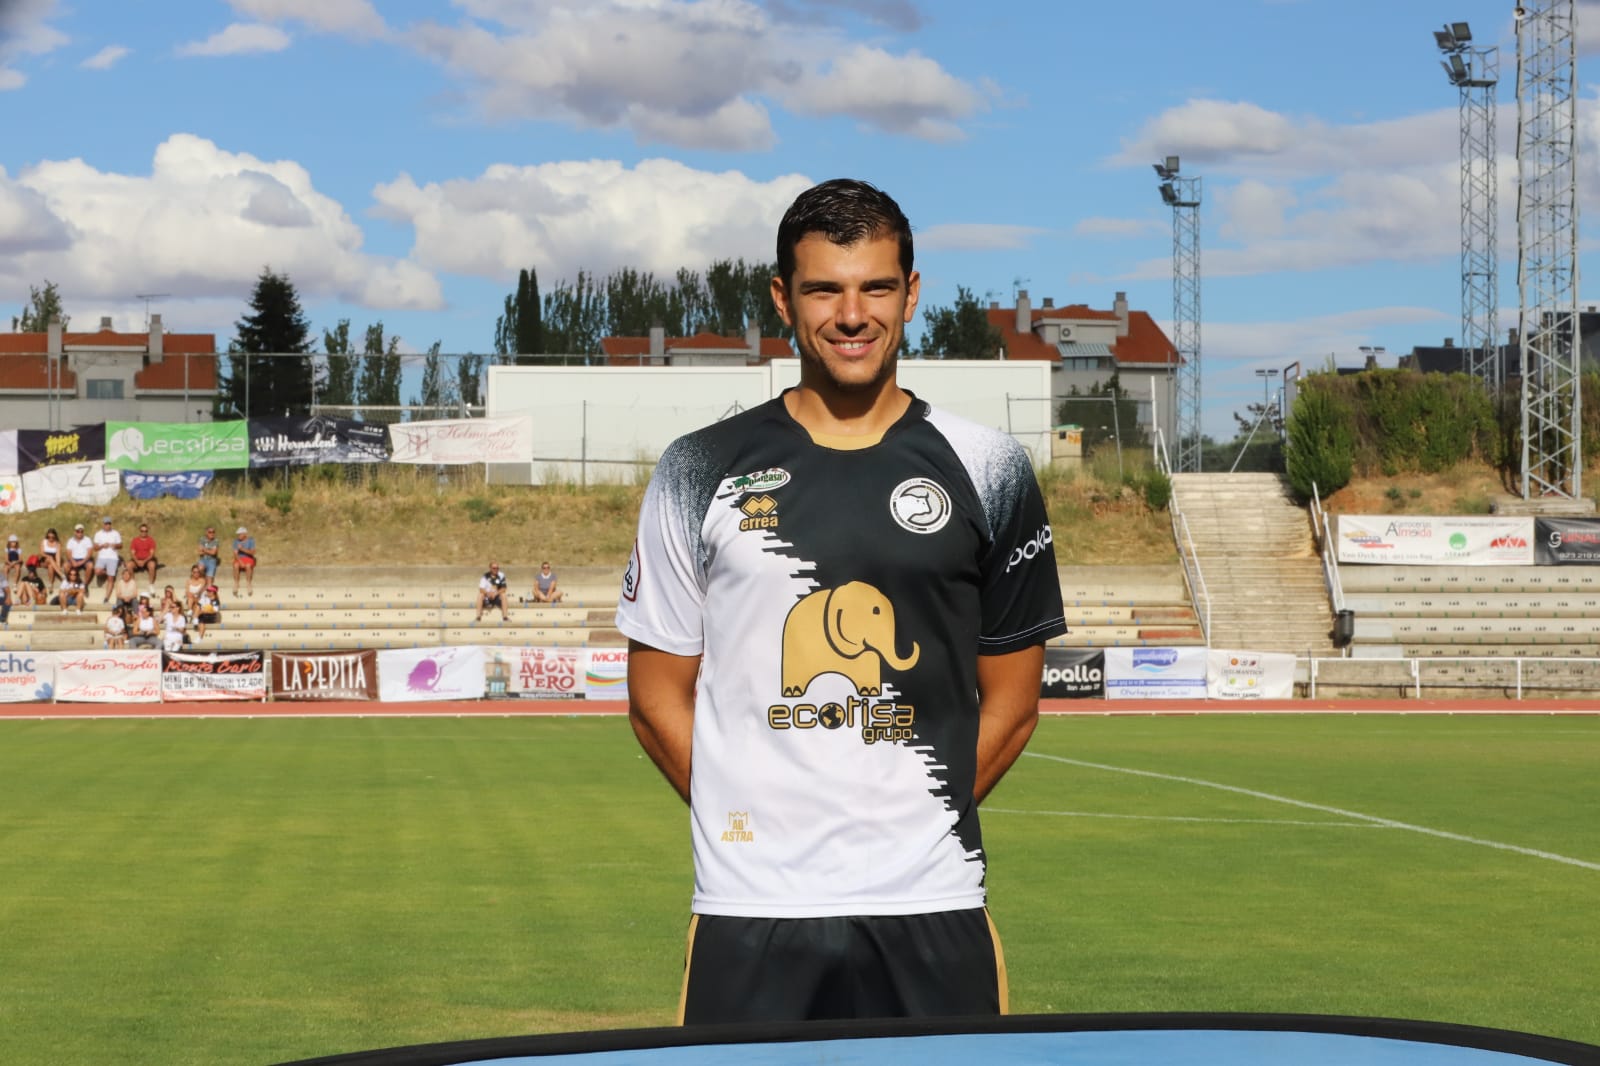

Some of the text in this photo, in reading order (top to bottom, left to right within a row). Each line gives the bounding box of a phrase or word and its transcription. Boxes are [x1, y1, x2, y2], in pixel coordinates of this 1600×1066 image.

[282, 655, 367, 691] LA PEPITA
[520, 675, 576, 692] TERO
[862, 727, 913, 745] grupo
[720, 831, 754, 842] ASTRA
